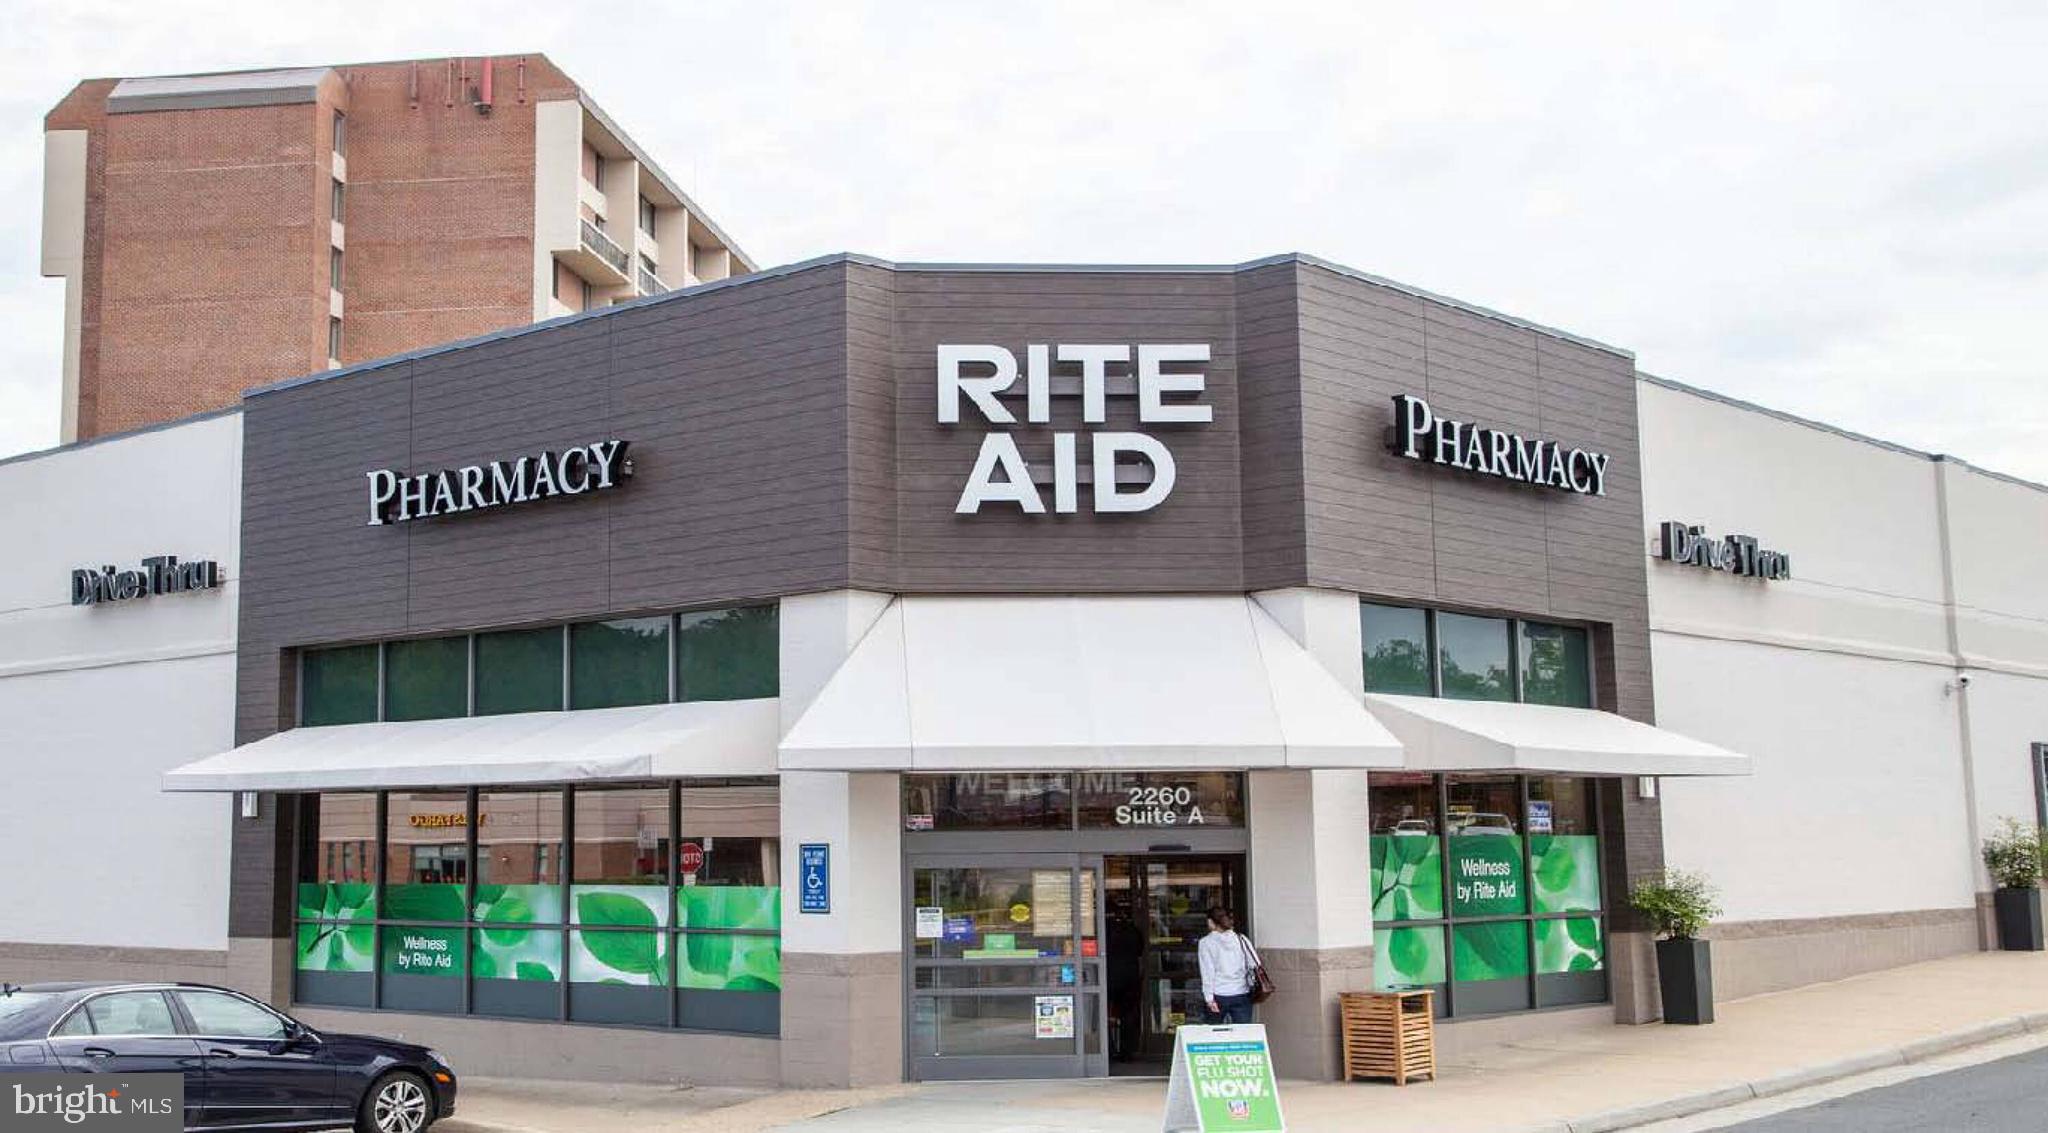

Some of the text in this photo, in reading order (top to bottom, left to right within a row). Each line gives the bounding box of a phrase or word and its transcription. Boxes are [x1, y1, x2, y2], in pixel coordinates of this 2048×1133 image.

[937, 344, 1213, 423] RITE
[1402, 394, 1611, 496] PHARMACY
[955, 432, 1177, 514] AID
[366, 440, 621, 526] PHARMACY
[1665, 520, 1791, 580] Drive Thru
[72, 555, 215, 606] Drive Thru
[1129, 787, 1190, 805] 2260
[1115, 805, 1204, 824] Suite A
[1461, 858, 1510, 876] Wellness
[1457, 880, 1516, 903] by Rite Aid
[403, 936, 448, 951] Wellness
[399, 952, 411, 969] by
[435, 953, 452, 967] Aid
[1195, 1054, 1264, 1066] GET YOUR
[1197, 1066, 1264, 1077] FLU SHOT
[1200, 1079, 1269, 1098] NOW.
